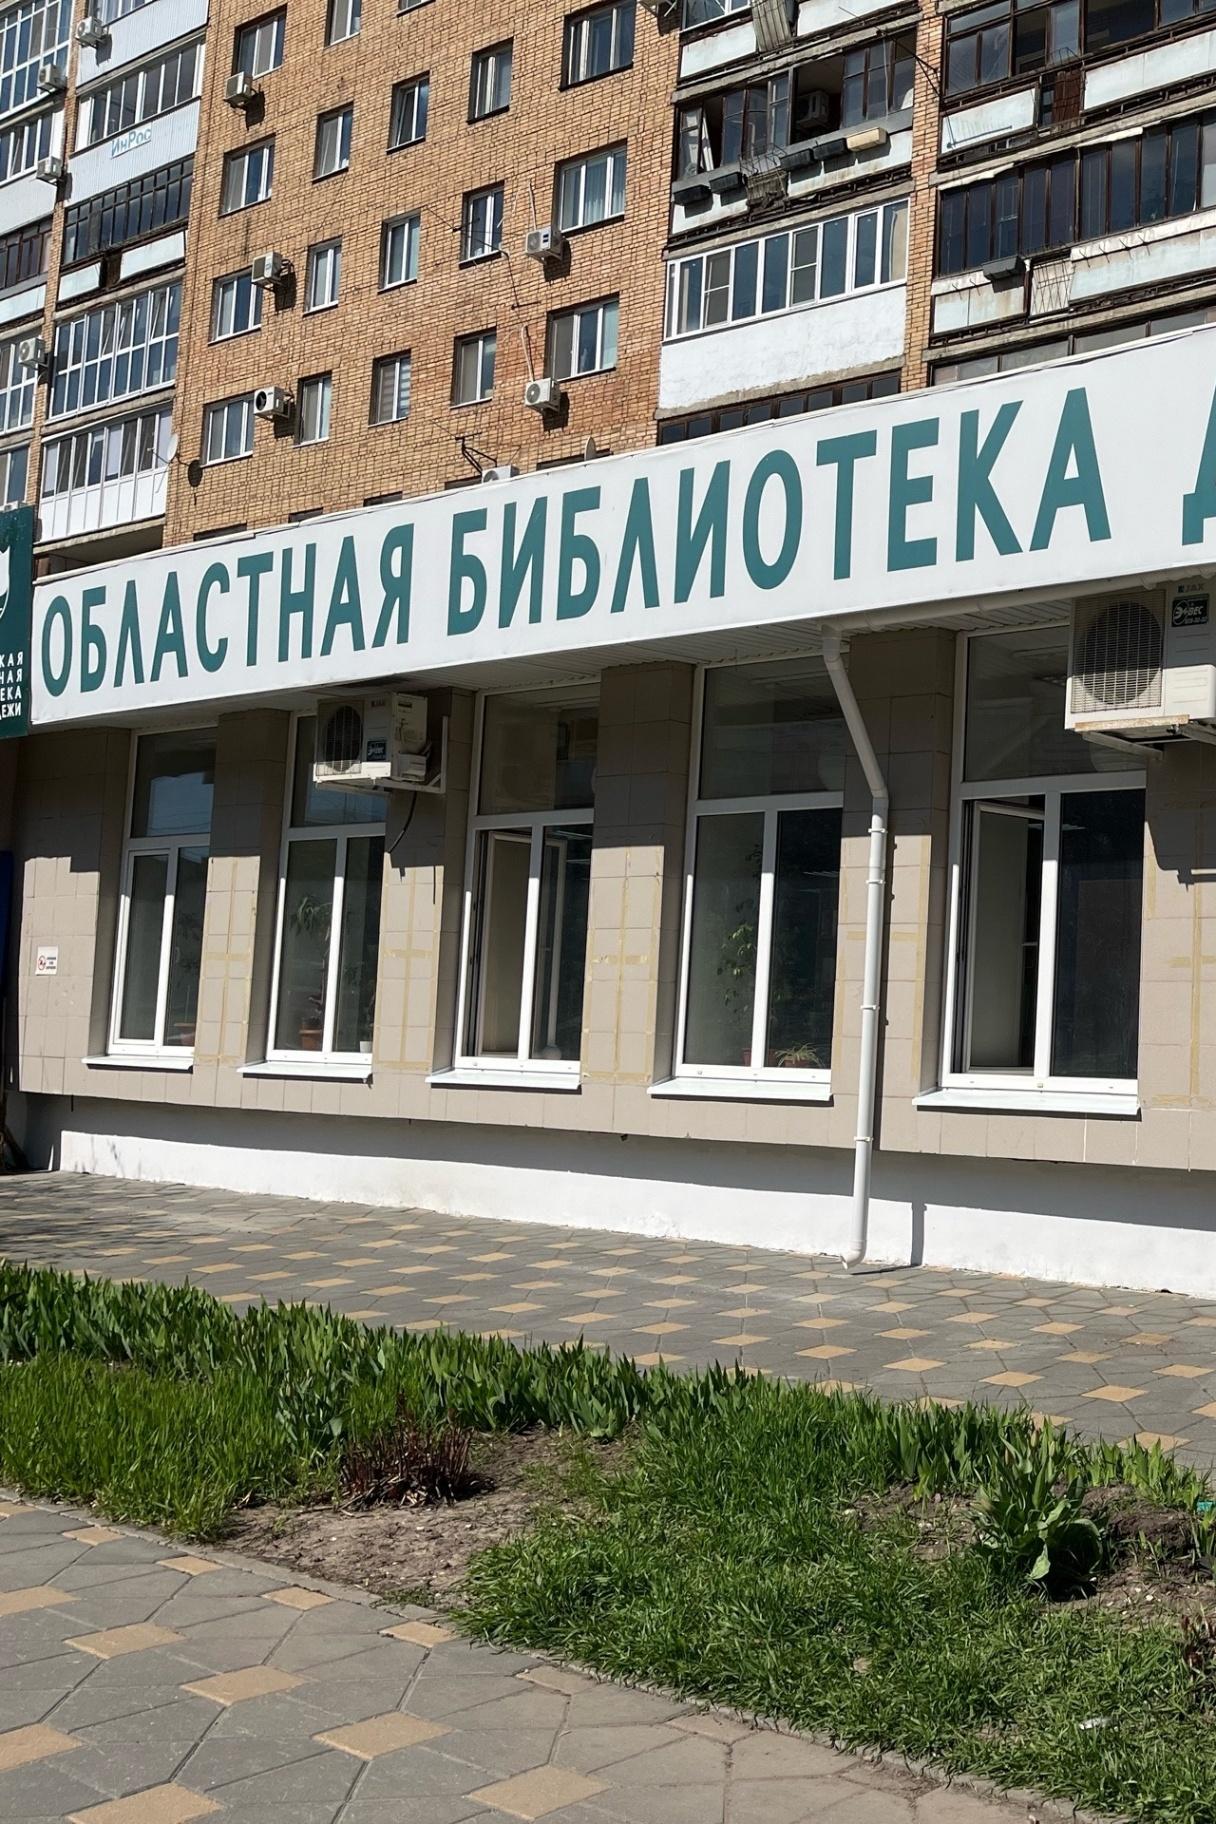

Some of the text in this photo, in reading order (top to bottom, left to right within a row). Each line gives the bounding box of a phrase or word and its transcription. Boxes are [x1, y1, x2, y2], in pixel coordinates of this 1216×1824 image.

[40, 523, 415, 698] ОБЛАСТНАЯ
[447, 387, 1111, 635] БИБЛИОТЕКА
[0, 702, 21, 720] ЕЖИ
